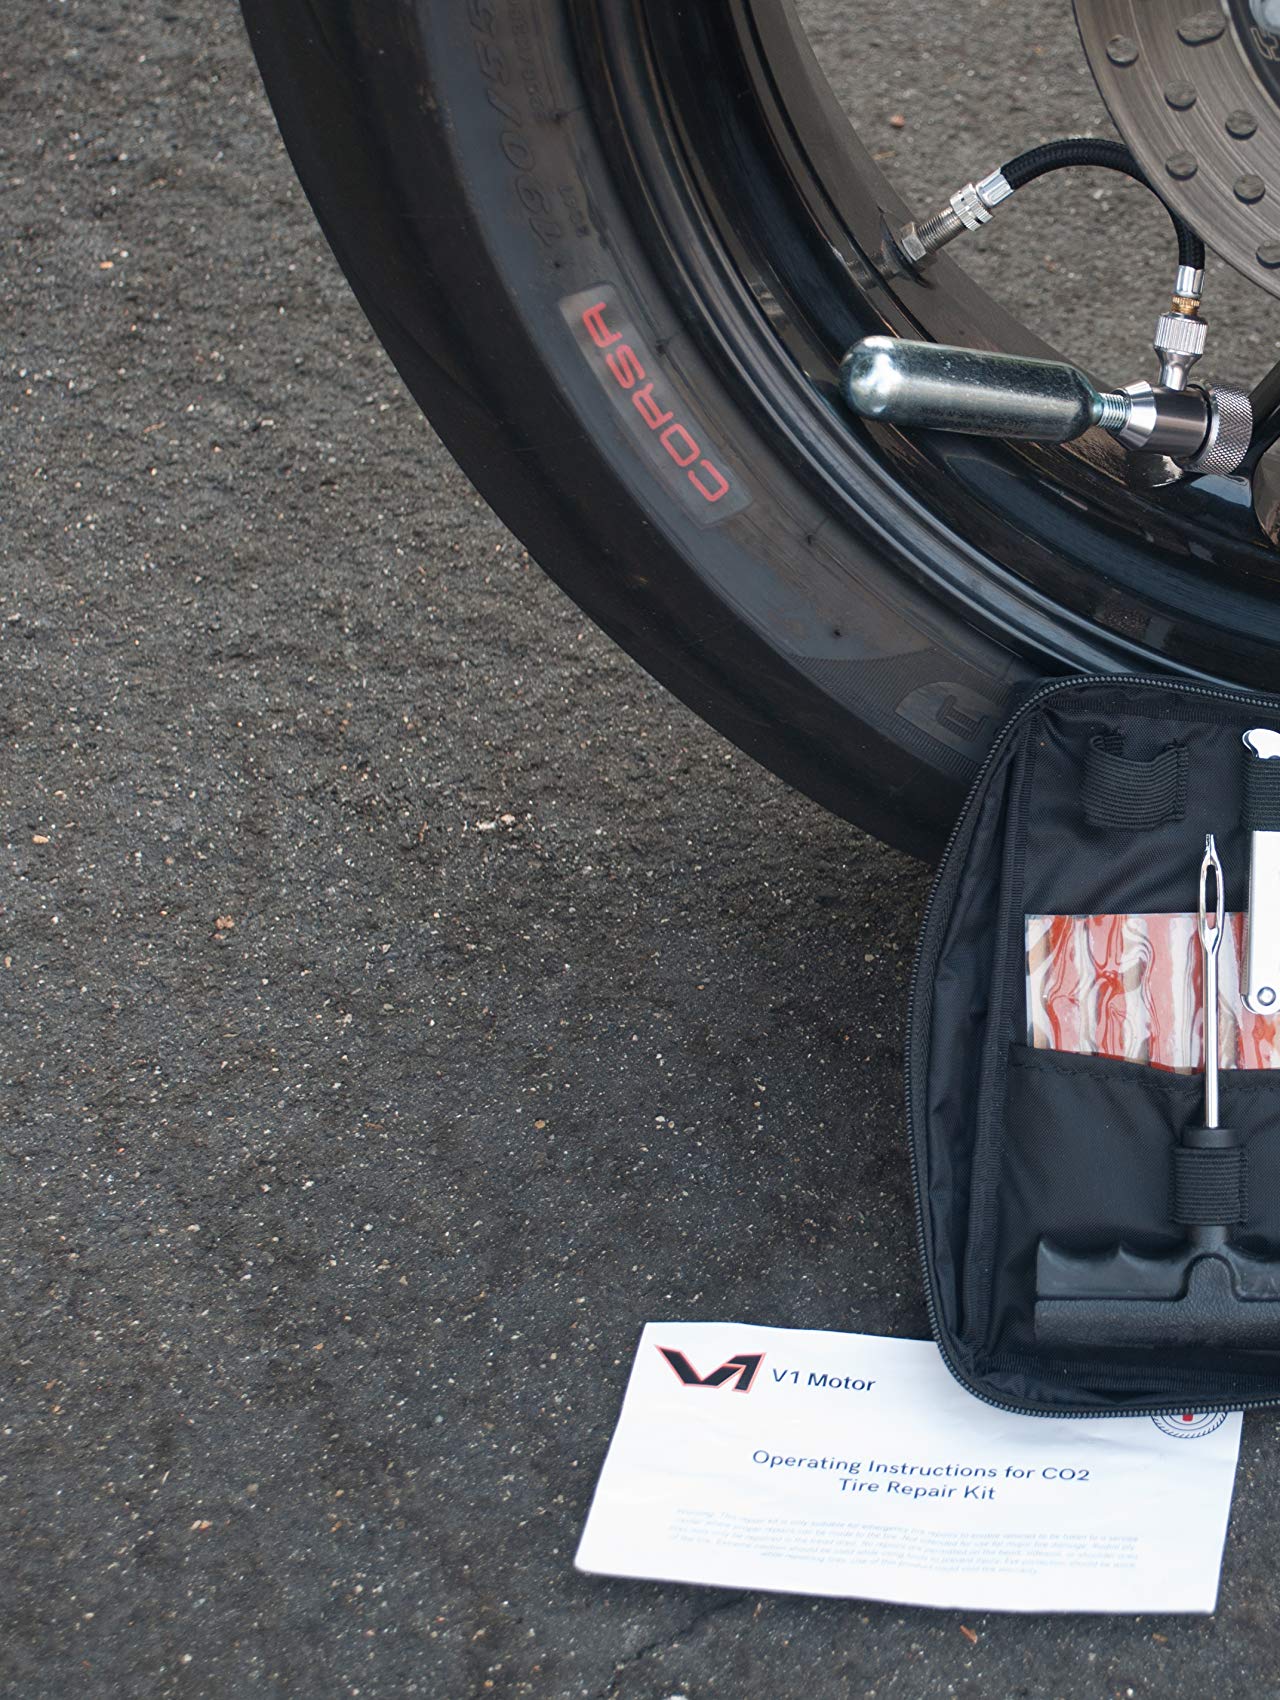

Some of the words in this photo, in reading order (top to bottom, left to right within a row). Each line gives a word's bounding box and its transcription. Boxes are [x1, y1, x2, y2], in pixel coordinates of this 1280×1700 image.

[581, 302, 729, 502] CORSA
[771, 1367, 801, 1385] V1
[806, 1371, 877, 1392] Motor
[751, 1449, 862, 1475] Operating
[867, 1459, 998, 1479] Instructions
[1003, 1464, 1036, 1480] for
[1040, 1466, 1091, 1482] CO2
[838, 1477, 879, 1493] Tire
[886, 1480, 958, 1500] Repair
[963, 1484, 996, 1501] Kit
